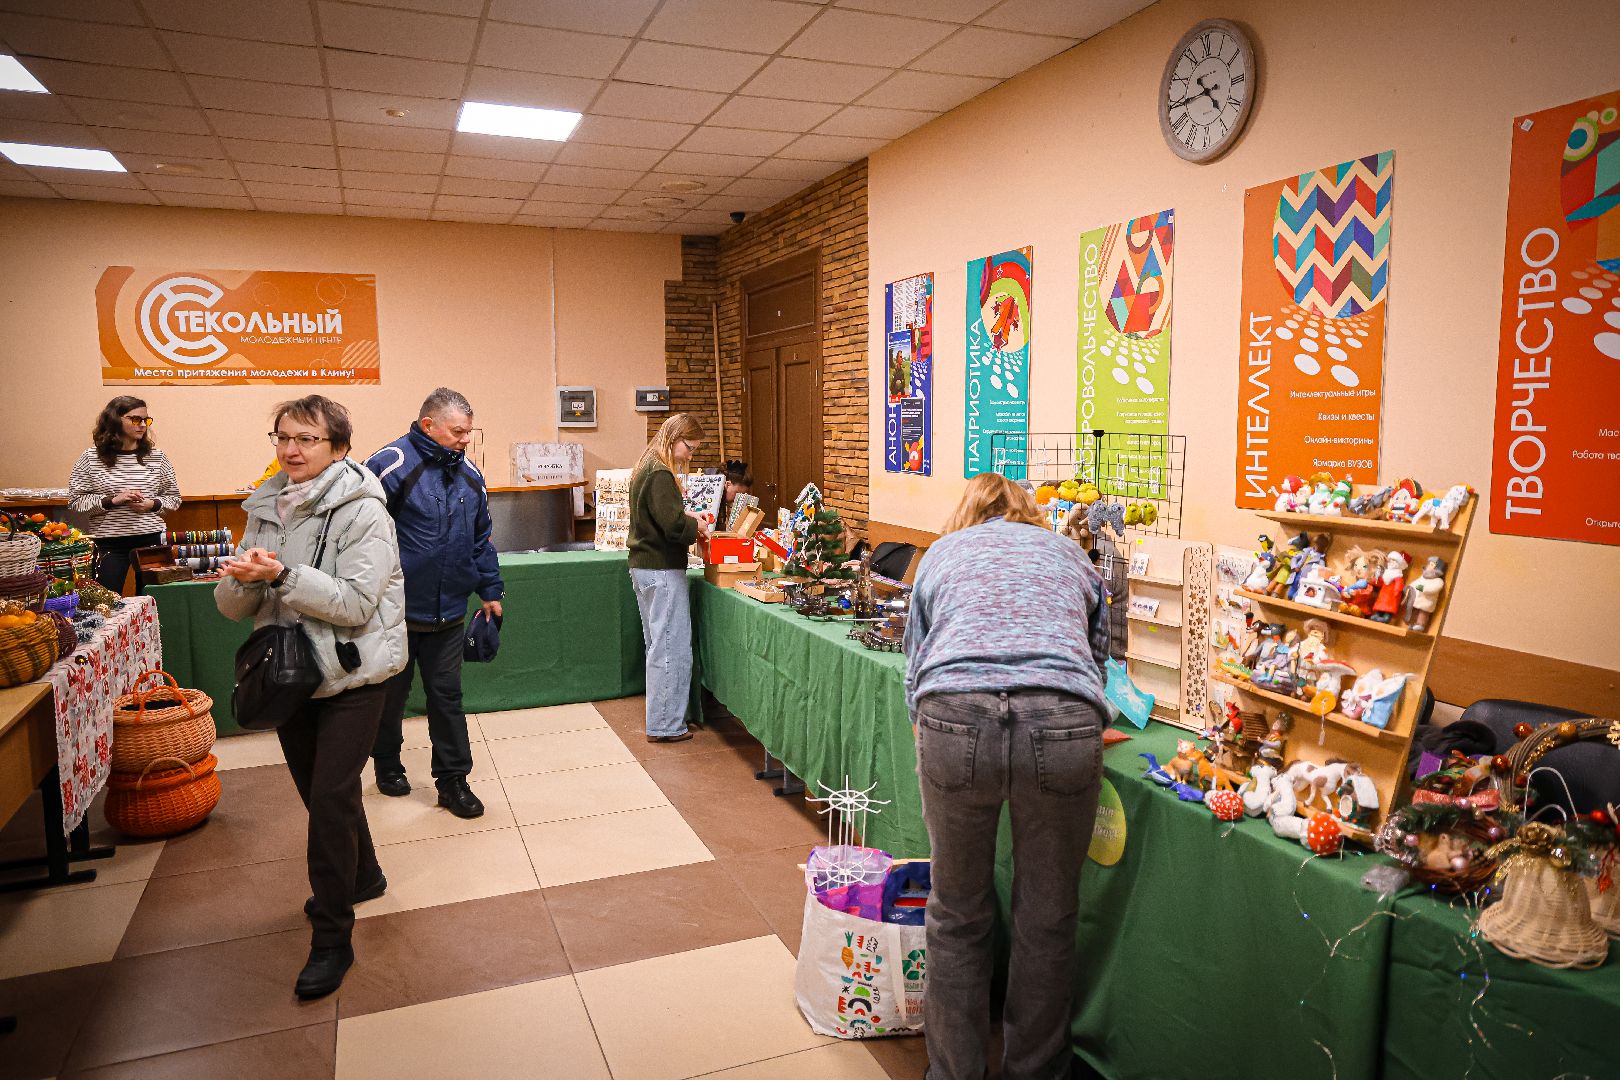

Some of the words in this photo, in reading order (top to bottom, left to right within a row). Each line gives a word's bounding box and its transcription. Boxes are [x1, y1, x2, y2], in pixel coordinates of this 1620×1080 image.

[240, 333, 313, 345] МОЛОДЕЖНЫЙ
[134, 367, 174, 377] Место
[177, 368, 247, 379] притяжения
[250, 368, 309, 378] молодежи
[311, 369, 317, 377] в
[320, 368, 355, 378] Клину!
[1505, 227, 1560, 519] ТВОРЧЕСТВО
[968, 318, 982, 472] ПАТРИОТИКА
[1290, 389, 1355, 399] Интеллектуальные
[1357, 389, 1376, 399] игры
[1245, 311, 1272, 498] ИНТЕЛЛЕКТ
[1318, 413, 1340, 421] Квизы
[1348, 413, 1375, 421] квесты
[1304, 435, 1374, 445] Онлайн-викторины
[1572, 449, 1604, 459] Работа
[1312, 459, 1346, 469] Ярмарка
[1347, 459, 1373, 469] ВУЗОВ
